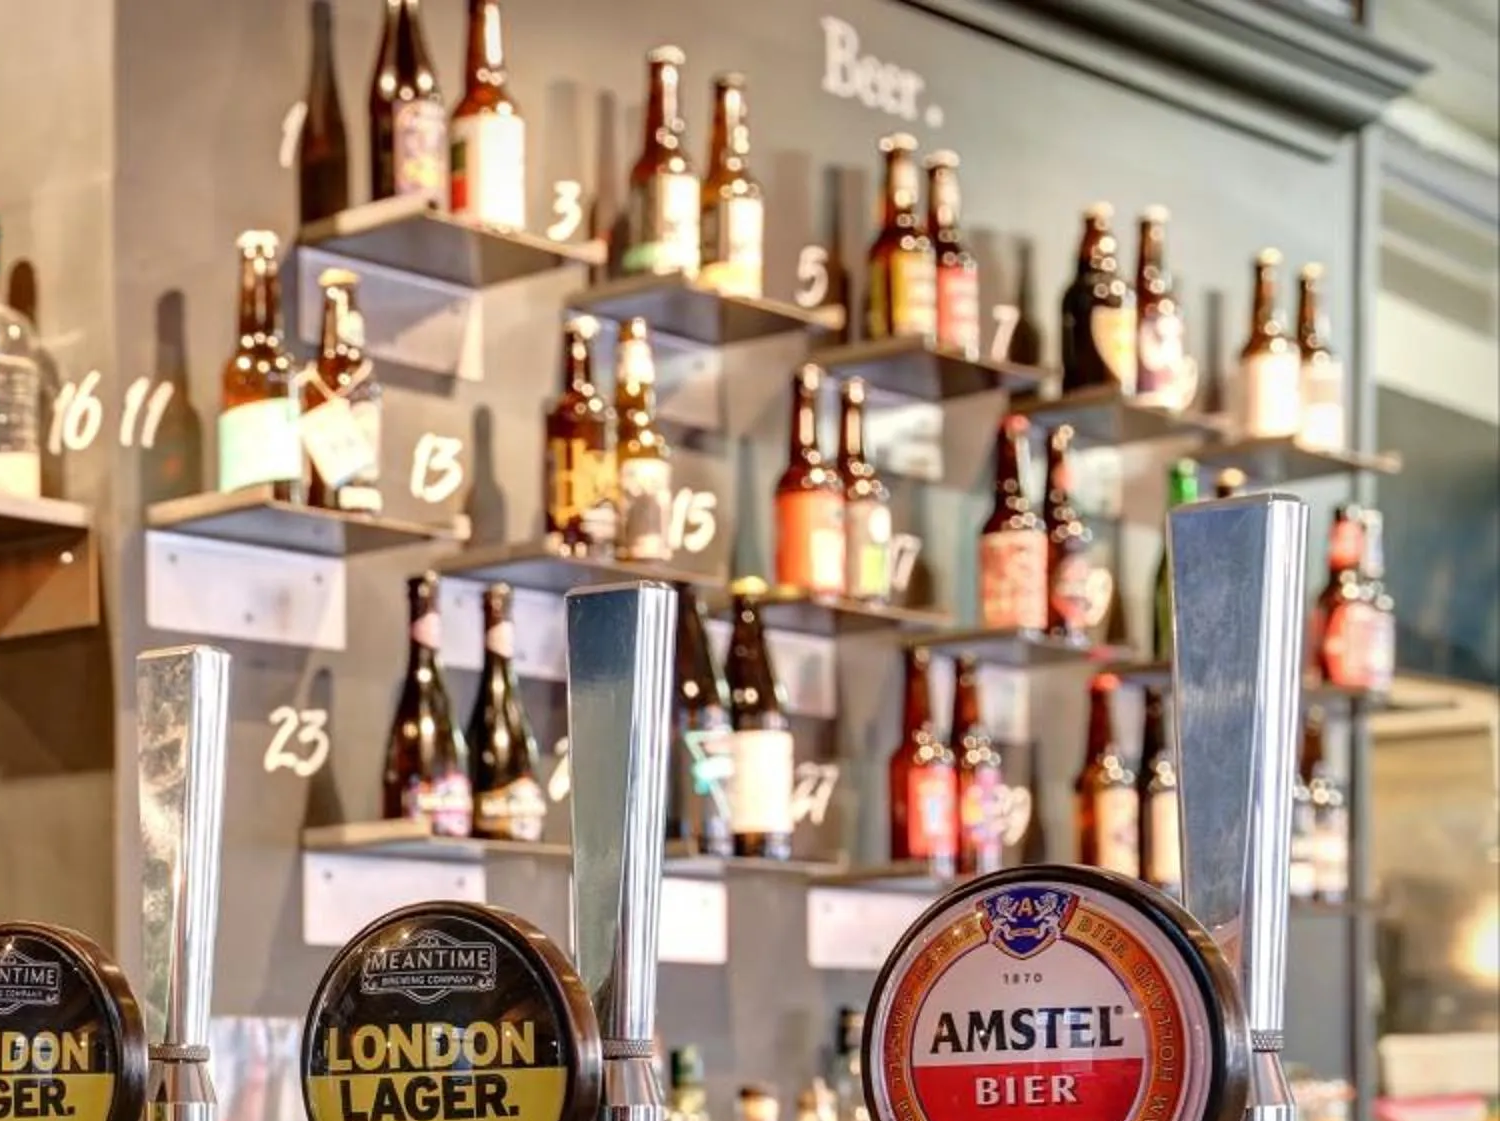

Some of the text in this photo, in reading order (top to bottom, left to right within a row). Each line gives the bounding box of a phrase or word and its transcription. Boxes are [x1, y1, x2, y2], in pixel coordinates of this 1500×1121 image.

[547, 180, 583, 241] 3
[796, 245, 829, 307] 5
[991, 304, 1020, 360] 7
[48, 370, 102, 456] 16
[119, 376, 173, 449] 11
[411, 432, 463, 501] 13
[669, 487, 717, 553] 15
[264, 707, 329, 776] 23
[368, 950, 489, 971] MEANTIME
[381, 975, 475, 986] BREWING COMPANY
[1002, 973, 1043, 985] 1870
[328, 1021, 535, 1070] LONDON
[930, 1006, 1125, 1054] AMSTEL
[975, 1074, 1079, 1107] BIER
